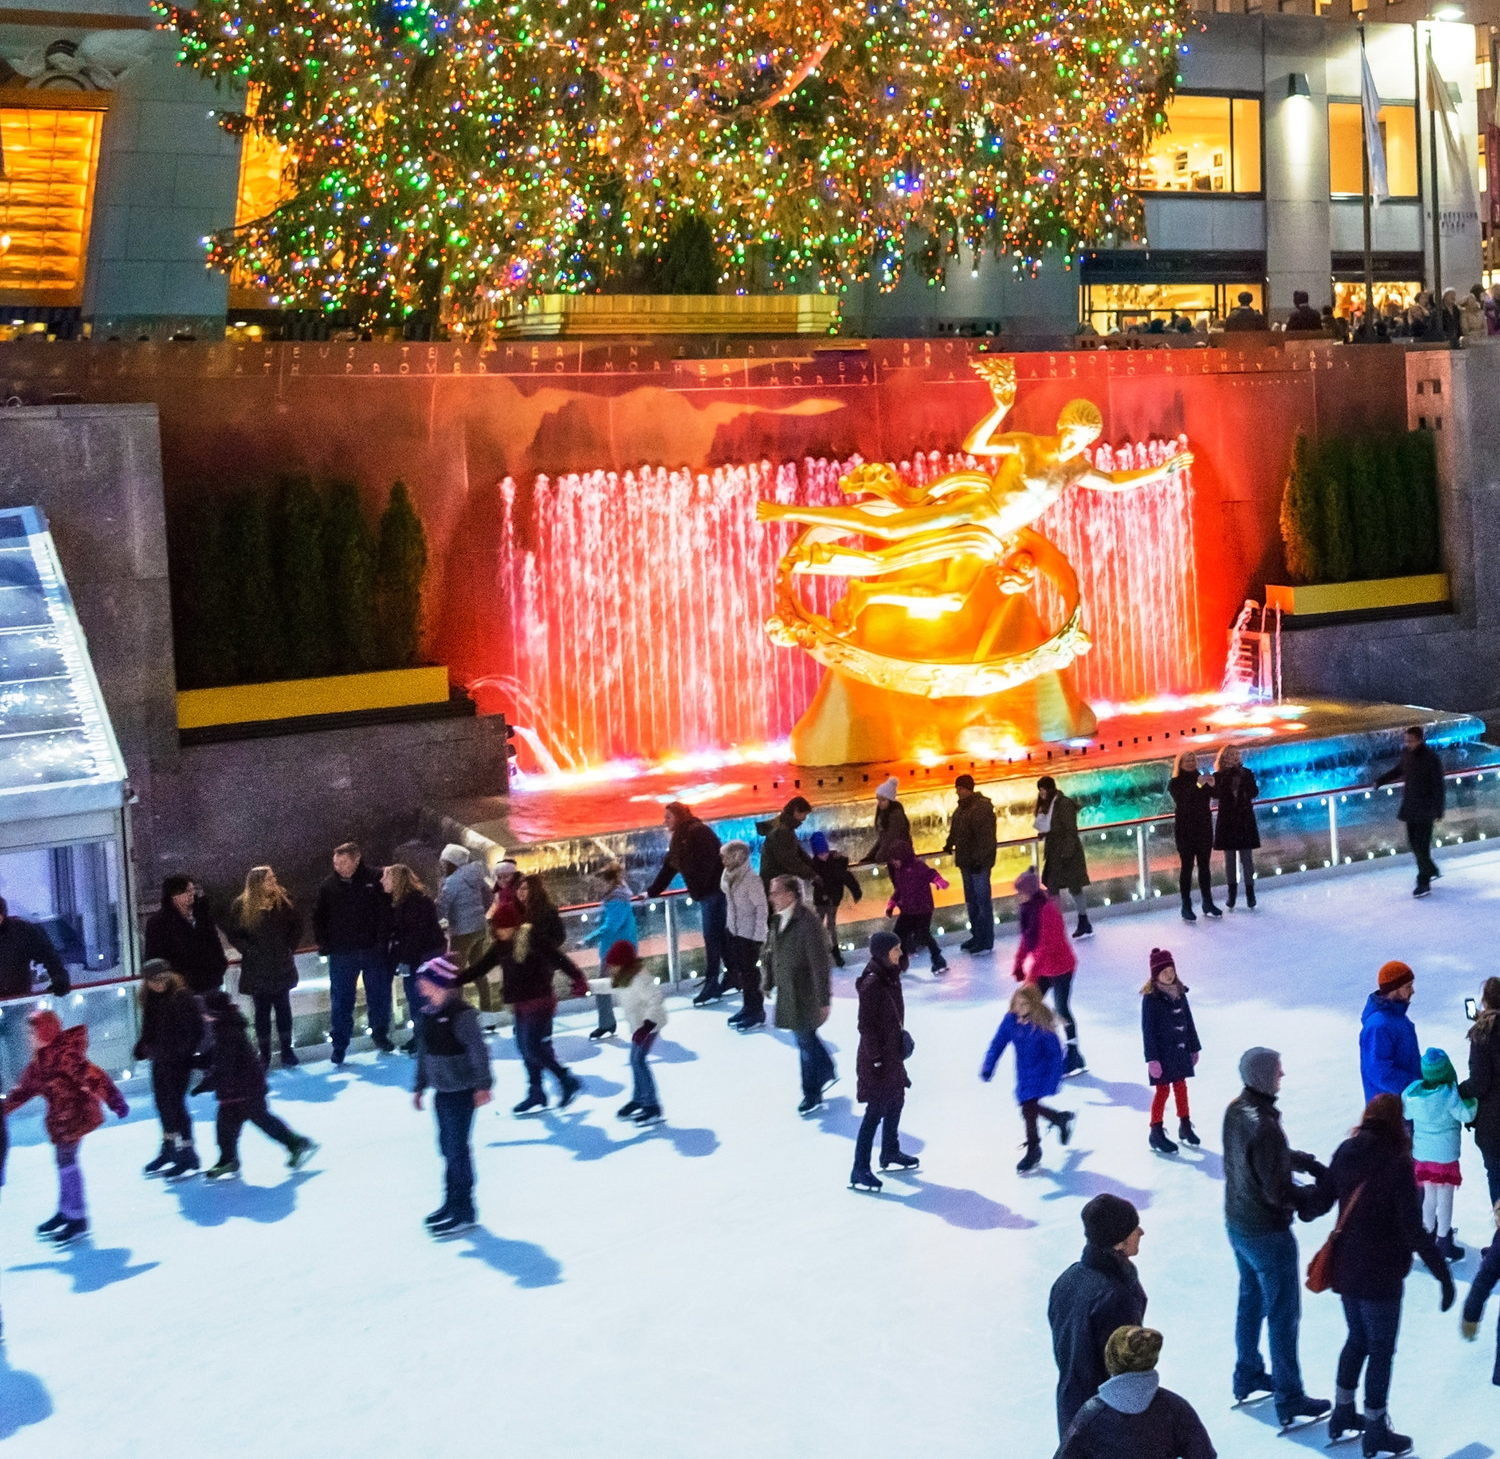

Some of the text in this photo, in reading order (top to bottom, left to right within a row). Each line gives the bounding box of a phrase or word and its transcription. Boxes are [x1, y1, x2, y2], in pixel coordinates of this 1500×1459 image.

[1202, 351, 1245, 362] THE
[345, 362, 487, 374] PROVED
[530, 361, 565, 373] TO
